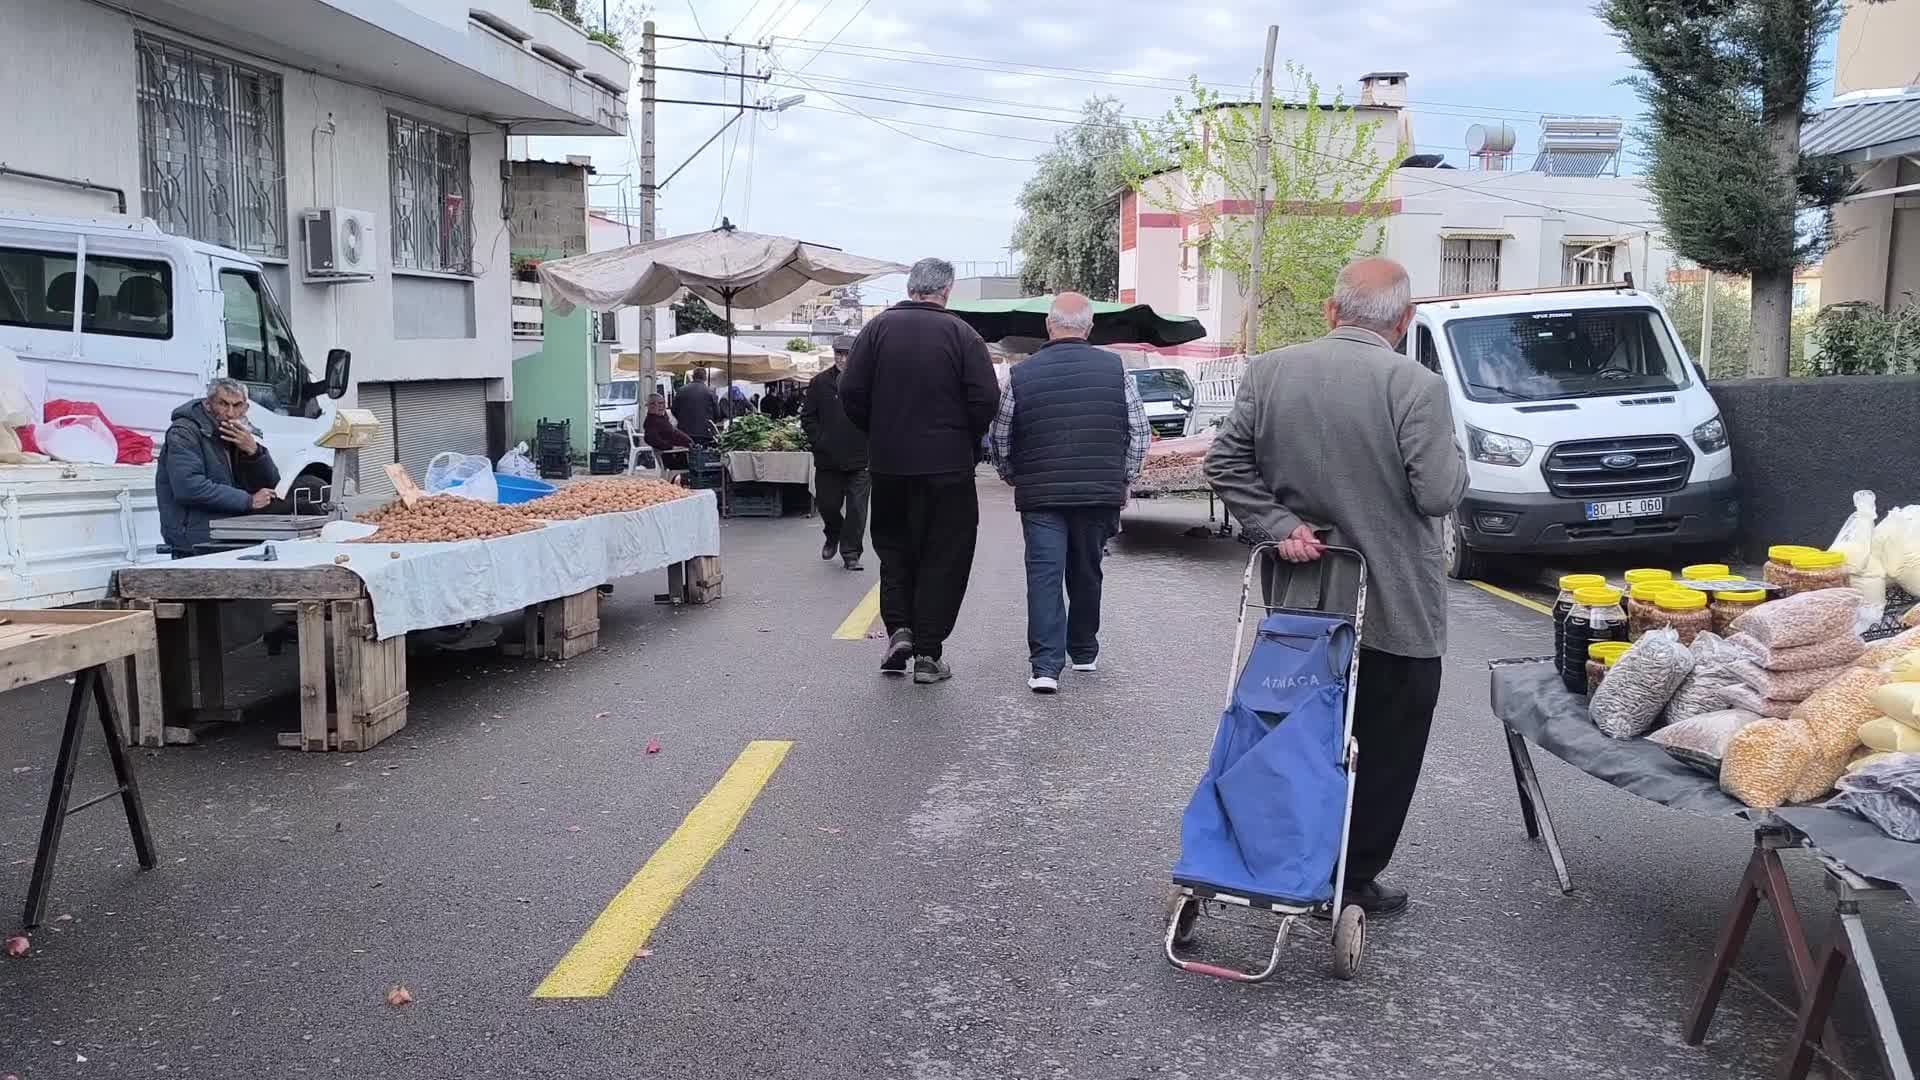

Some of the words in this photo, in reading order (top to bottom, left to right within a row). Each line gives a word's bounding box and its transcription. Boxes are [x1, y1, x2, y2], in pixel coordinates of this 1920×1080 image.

[1593, 503, 1607, 515] 80
[1618, 501, 1632, 513] LE
[1640, 499, 1661, 512] 060
[1261, 674, 1320, 689] ATMACA
